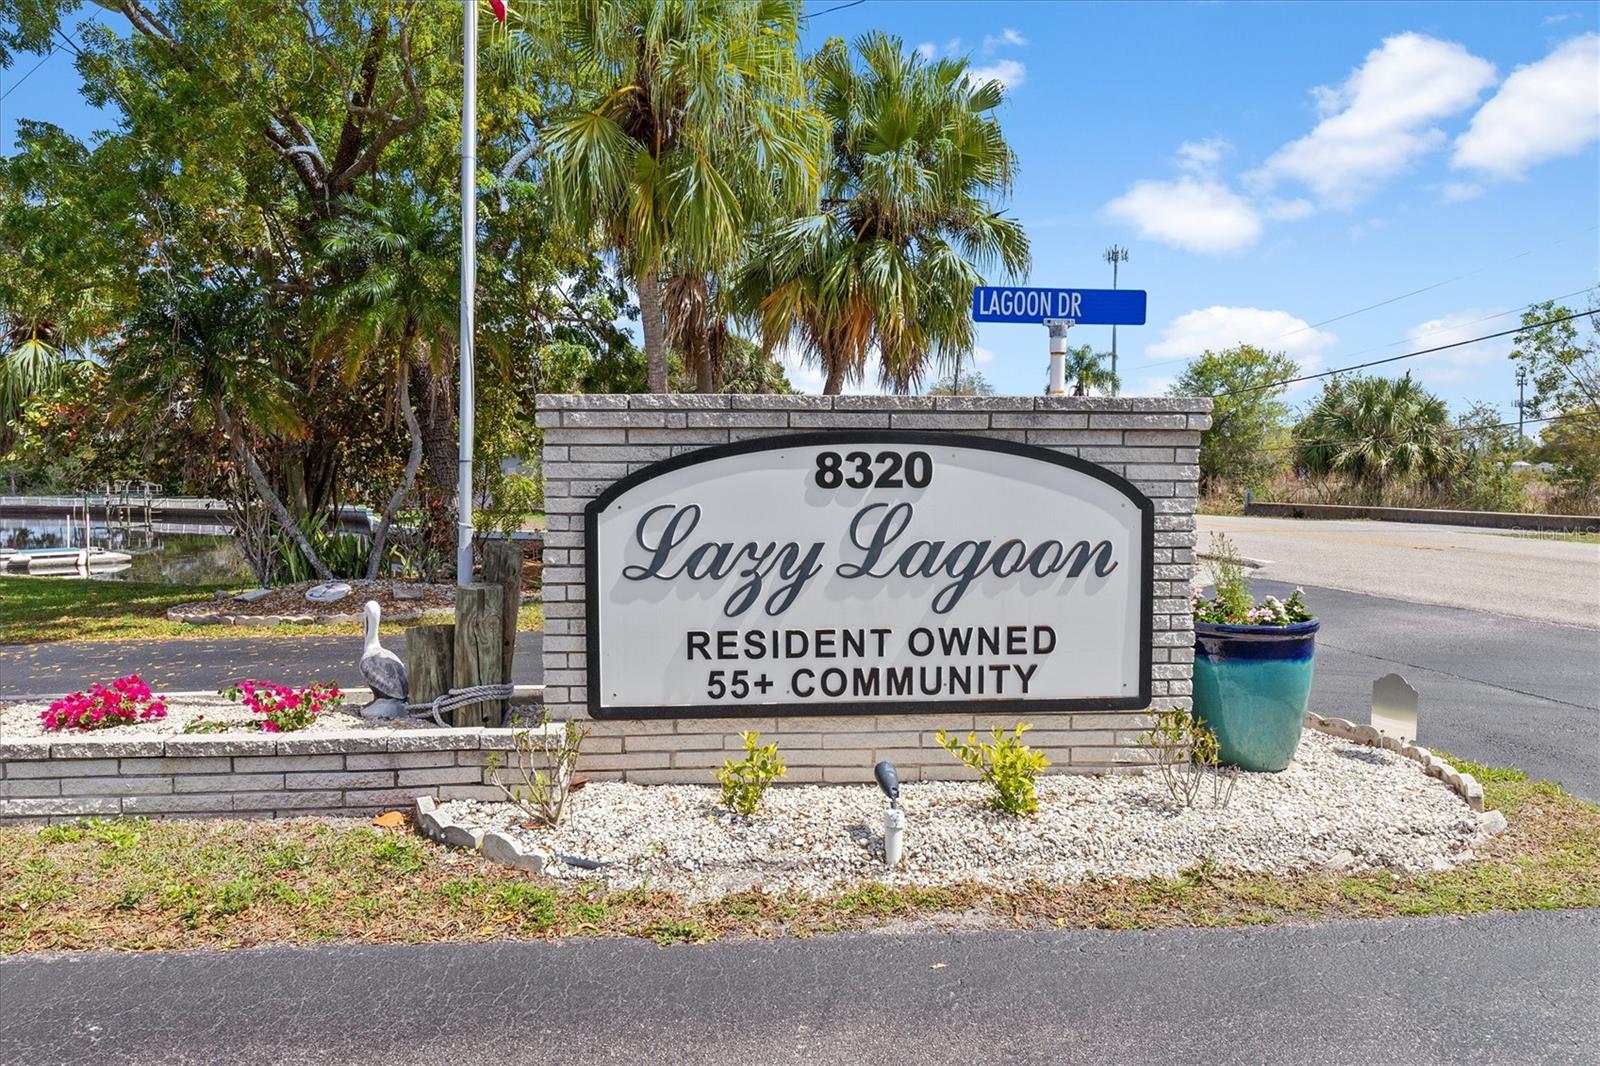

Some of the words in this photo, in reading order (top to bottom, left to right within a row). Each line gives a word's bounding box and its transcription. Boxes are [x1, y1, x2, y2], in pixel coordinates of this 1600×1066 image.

[979, 289, 1052, 317] LAGOON
[1058, 292, 1082, 317] DR
[814, 451, 934, 489] 8320
[622, 503, 825, 617] Lazy
[836, 502, 1118, 615] Lagoon
[686, 628, 893, 660] RESIDENT
[908, 625, 1058, 657] OWNED
[706, 668, 774, 699] 55+
[790, 664, 1037, 698] COMMUNITY
